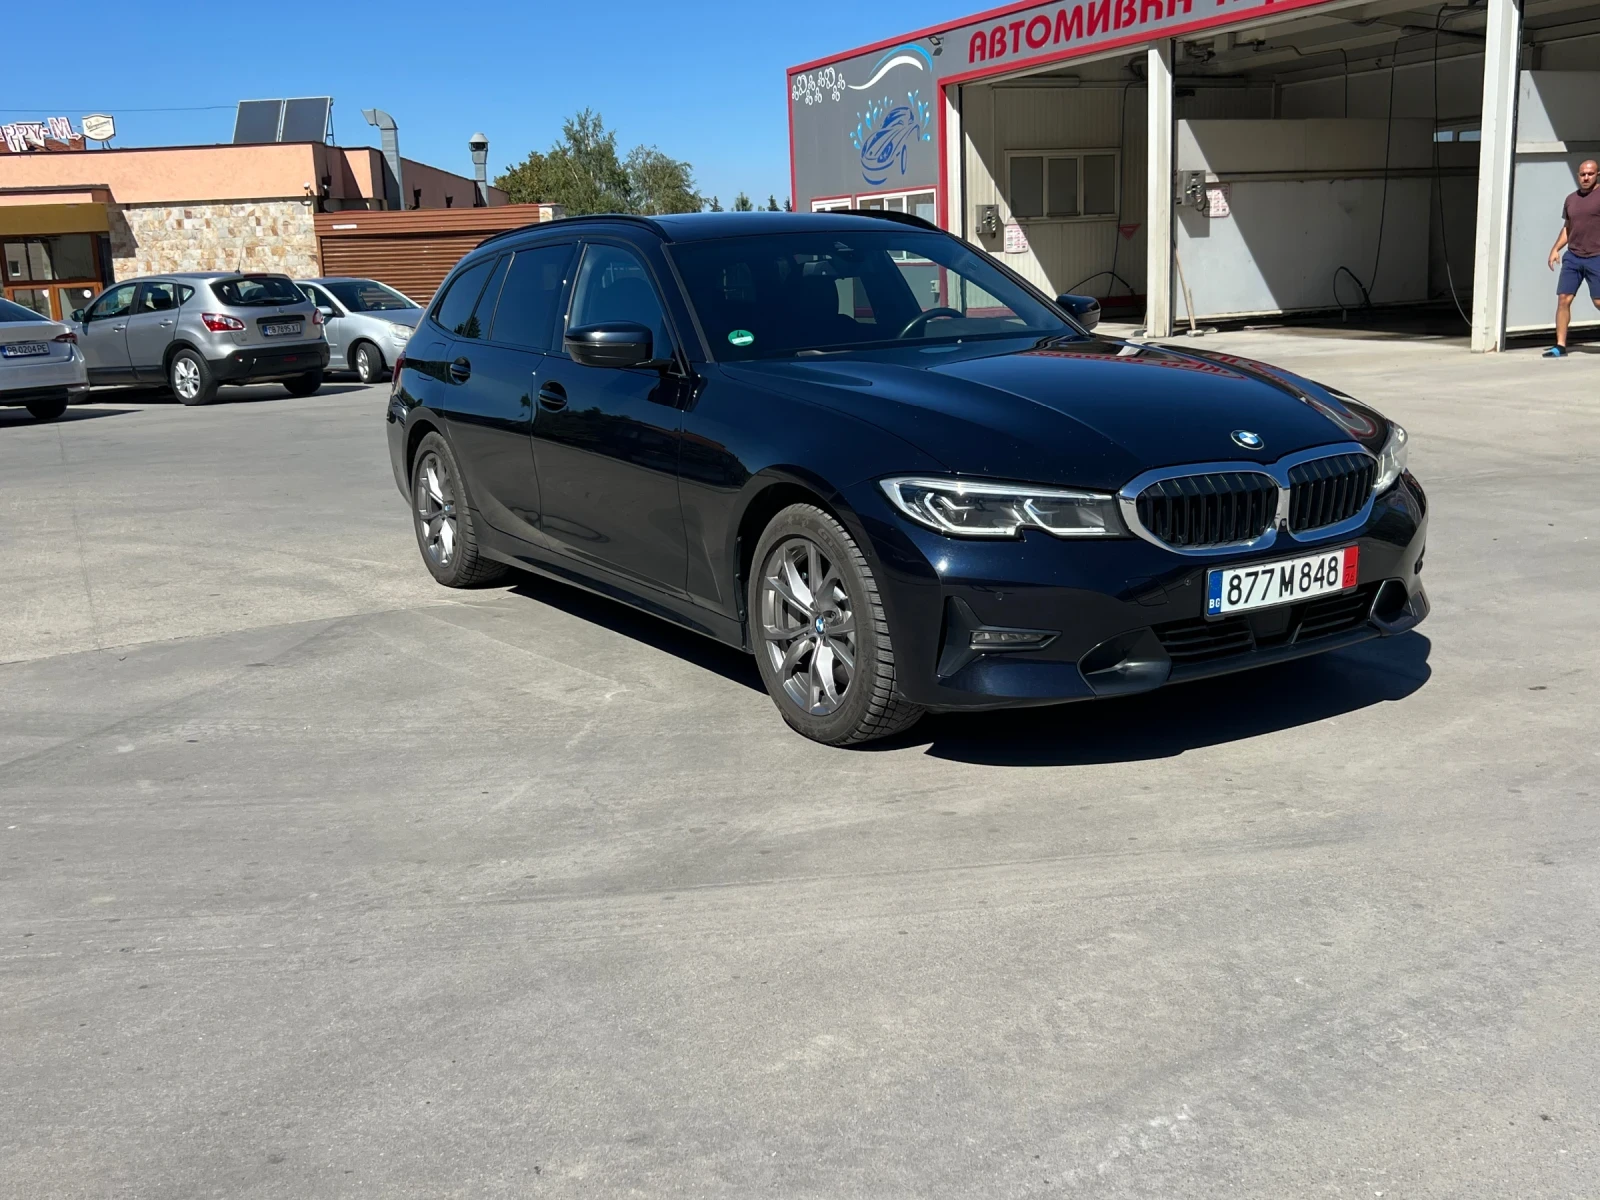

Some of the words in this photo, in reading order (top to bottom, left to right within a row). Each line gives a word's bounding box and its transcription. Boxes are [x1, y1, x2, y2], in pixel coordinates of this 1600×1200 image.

[0, 117, 73, 153] PPY-M
[18, 345, 36, 354] 0204
[1209, 598, 1221, 608] BG
[1227, 567, 1275, 606] 877
[1278, 564, 1295, 598] M
[1299, 555, 1339, 593] 848
